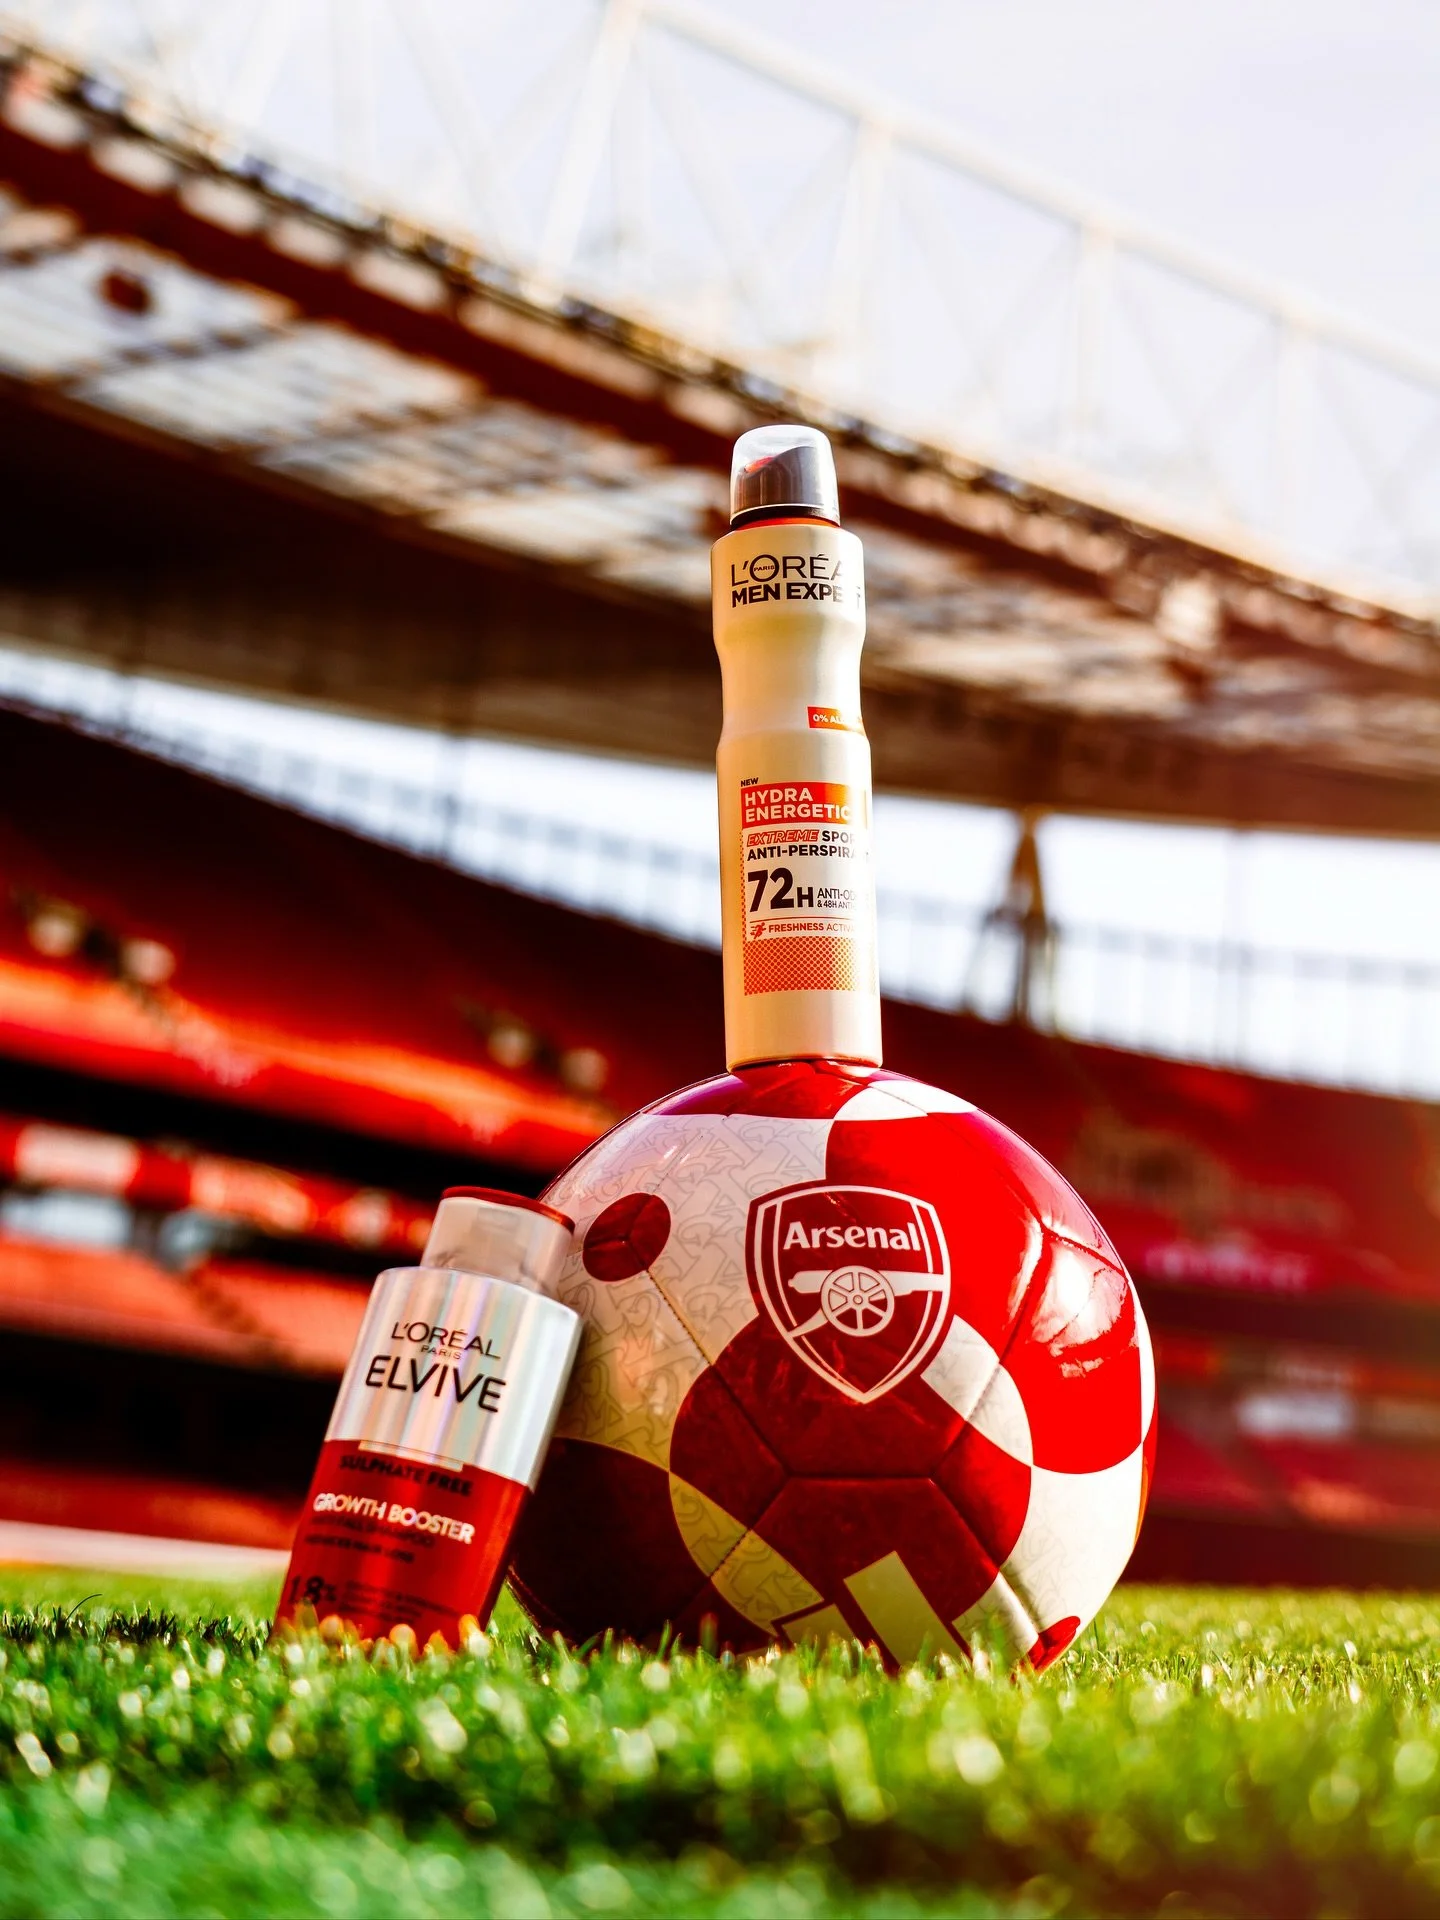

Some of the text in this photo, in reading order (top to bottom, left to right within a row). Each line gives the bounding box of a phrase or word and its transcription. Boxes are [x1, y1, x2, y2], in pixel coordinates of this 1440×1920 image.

[732, 583, 780, 608] MEN
[812, 714, 829, 723] 0%
[740, 777, 759, 787] NEW
[744, 787, 814, 808] HYDRA
[745, 803, 851, 823] ENERGETIC
[747, 829, 820, 847] EXTREME
[747, 867, 814, 912] 72H
[817, 900, 822, 908] &
[823, 900, 837, 908] 48H
[768, 922, 825, 933] FRESHNESS
[783, 1220, 921, 1251] Arsenal
[391, 1321, 501, 1360] L'ORÉAL
[420, 1345, 462, 1360] PARIS
[365, 1355, 507, 1413] ELVIVE
[340, 1455, 474, 1496] SULPHATE FREE
[313, 1493, 388, 1520] GROWTH
[387, 1503, 476, 1544] BOOSTER
